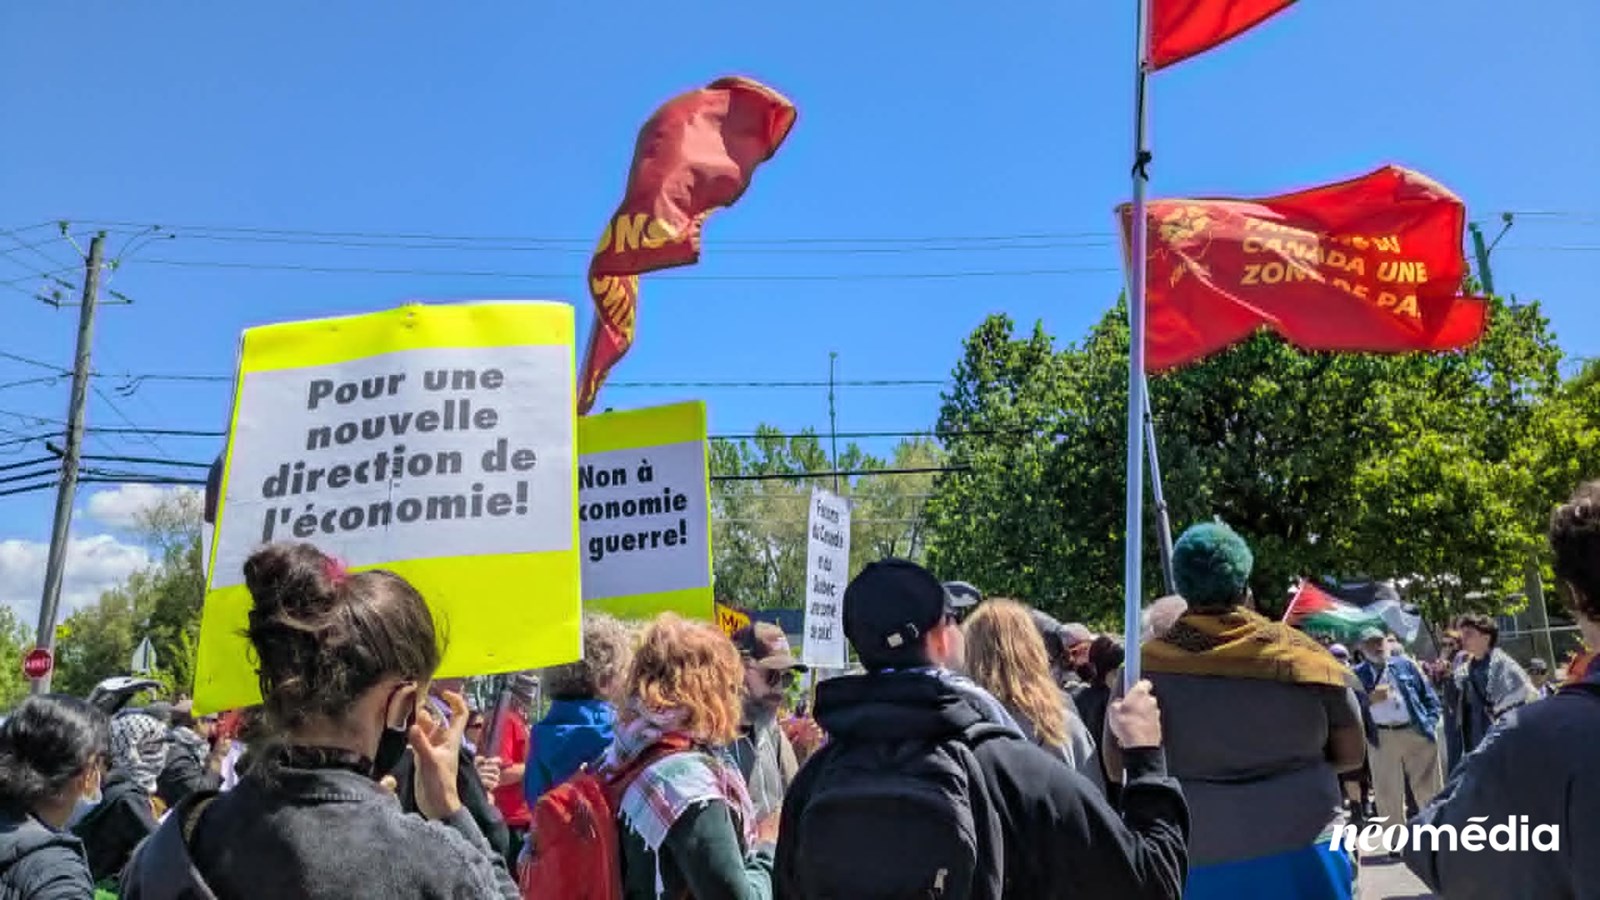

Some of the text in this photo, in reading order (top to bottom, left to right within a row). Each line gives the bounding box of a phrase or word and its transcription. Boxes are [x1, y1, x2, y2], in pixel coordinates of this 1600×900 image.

[1240, 262, 1321, 286] ZON
[1243, 237, 1366, 276] CANADA
[1376, 261, 1428, 283] UNE
[308, 367, 504, 410] Pour une
[306, 399, 499, 450] nouvelle
[262, 438, 537, 498] direction de
[578, 458, 653, 489] Non à
[262, 481, 528, 544] l'économie!
[589, 518, 687, 562] guerre!
